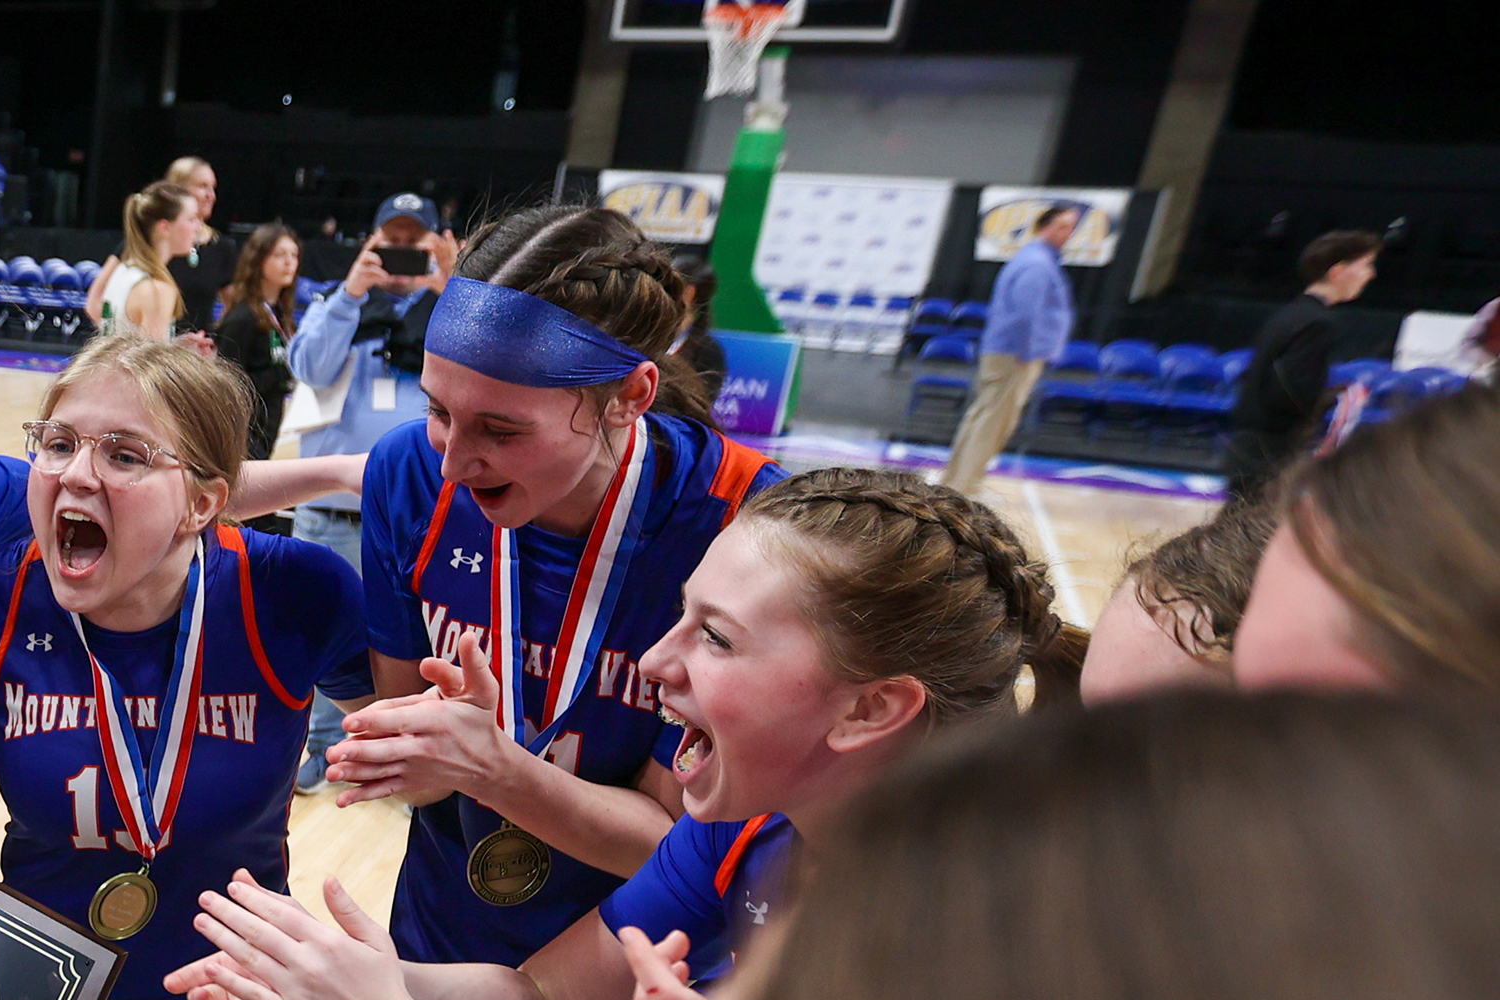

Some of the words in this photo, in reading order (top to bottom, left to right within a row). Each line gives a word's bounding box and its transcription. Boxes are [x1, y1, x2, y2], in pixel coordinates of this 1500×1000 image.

[4, 681, 157, 740] MOUNTIN
[198, 693, 258, 744] IEW
[597, 648, 657, 713] VIE
[65, 765, 173, 851] 1
